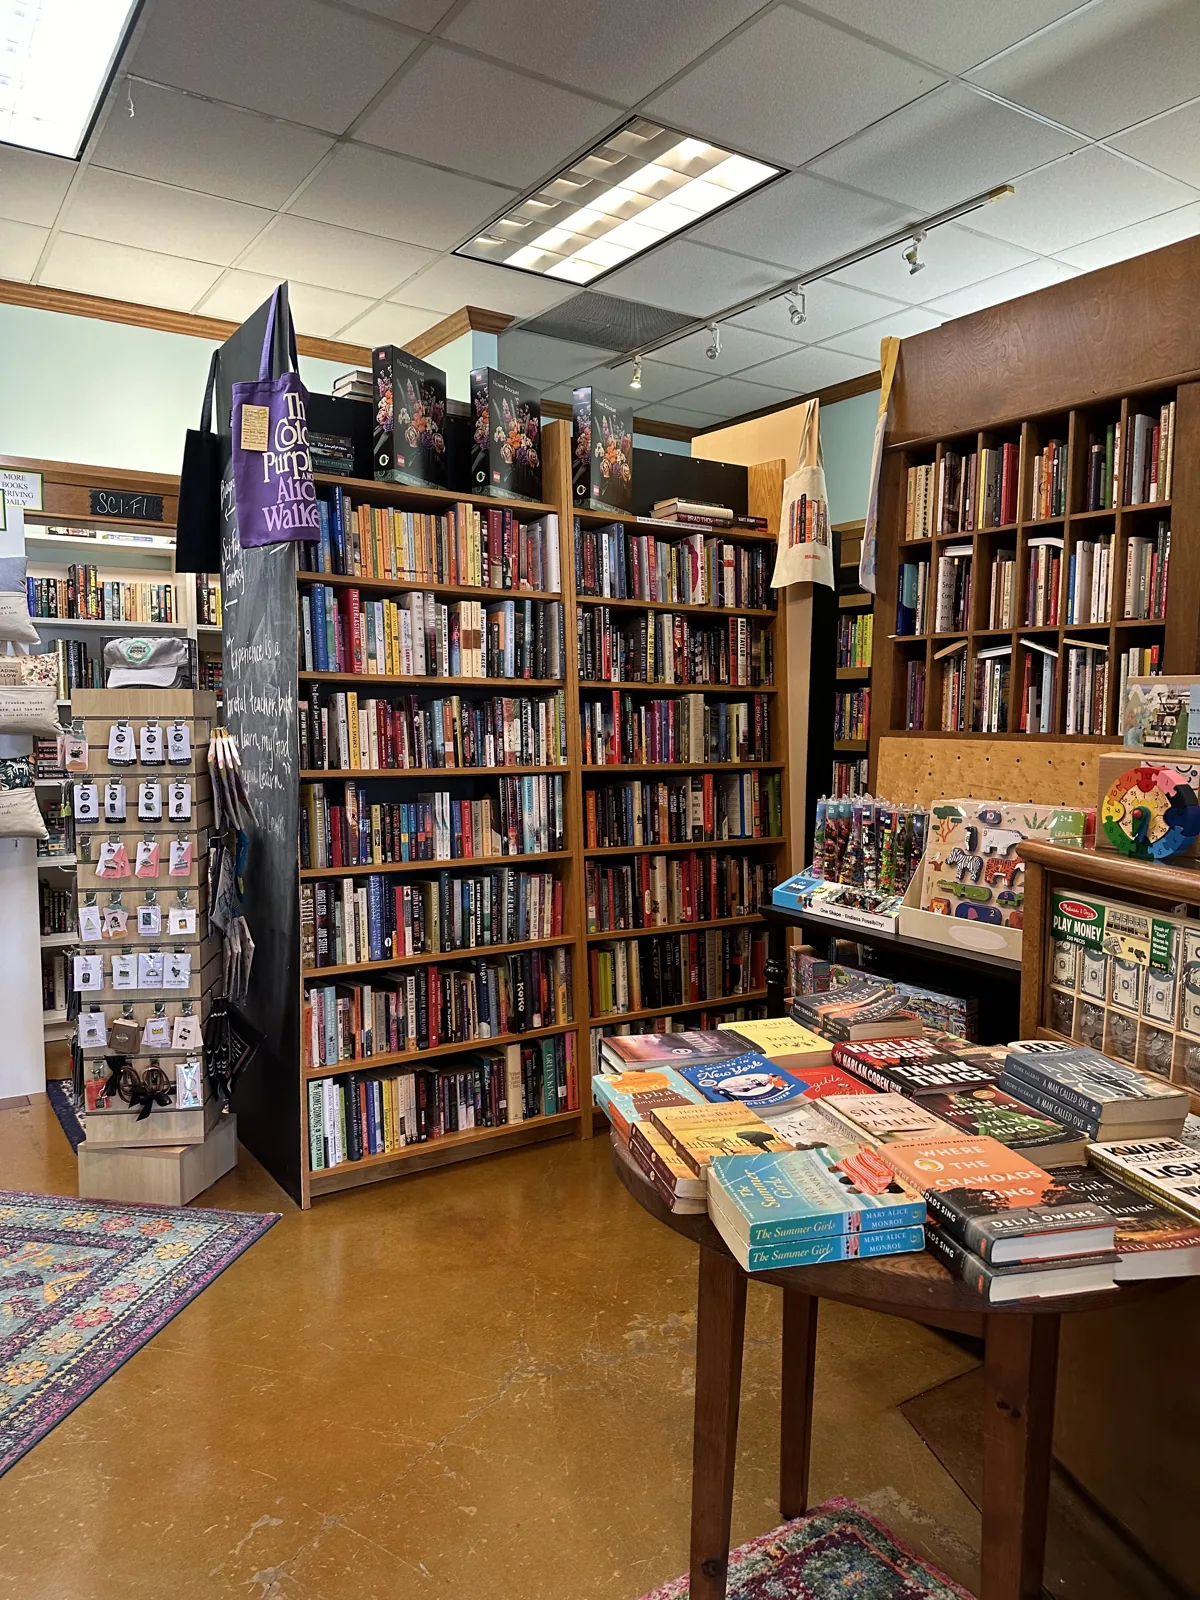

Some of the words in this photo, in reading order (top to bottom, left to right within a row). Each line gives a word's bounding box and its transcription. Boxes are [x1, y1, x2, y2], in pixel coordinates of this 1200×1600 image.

[396, 359, 409, 370] Flower
[409, 365, 425, 377] Bouquet
[492, 381, 505, 390] Flower
[505, 386, 520, 396] Bouquet
[283, 393, 306, 419] Th
[604, 403, 617, 414] Bouquet
[262, 450, 313, 483] Purpl
[4, 473, 26, 482] MORE
[2, 482, 29, 490] BOOKS
[277, 476, 316, 504] Alic
[4, 490, 34, 499] RRIVING
[6, 498, 27, 506] DAILY
[97, 492, 147, 516] SCI-FI
[262, 503, 320, 531] Walke
[264, 641, 274, 660] is
[274, 647, 281, 657] a
[311, 684, 319, 692] The
[226, 687, 248, 719] brutal
[279, 681, 293, 727] but
[1126, 775, 1133, 783] 11
[1111, 789, 1118, 797] 10
[1109, 826, 1114, 834] 8
[318, 890, 326, 904] ANGEL
[301, 899, 314, 925] STEELE
[829, 909, 841, 918] Shape
[845, 913, 861, 922] Endless
[862, 917, 885, 928] Possibility!
[1053, 915, 1073, 934] PLAY
[1073, 920, 1102, 942] MONEY
[319, 938, 328, 954] STEELE
[1074, 936, 1086, 945] PIECES
[517, 982, 525, 1012] KOKO
[813, 987, 874, 1006] TENDER
[846, 1039, 935, 1054] HARLAN
[867, 1047, 941, 1061] COBEN
[546, 1054, 554, 1079] GREEN
[697, 1067, 730, 1083] New
[730, 1060, 764, 1077] York
[842, 1055, 867, 1080] HARLAN
[866, 1069, 890, 1092] COBEN
[614, 1087, 691, 1102] Oliphant
[767, 1091, 792, 1104] SILVER
[1048, 1081, 1060, 1095] MAN
[1060, 1087, 1077, 1106] CALLED
[1077, 1097, 1090, 1112] OVE
[313, 1091, 322, 1128] HOMECOMING
[850, 1105, 917, 1118] SILENT
[945, 1101, 1019, 1118] HUSBANDS
[1041, 1099, 1053, 1112] MAN
[1053, 1105, 1073, 1123] CALLED
[1072, 1115, 1085, 1128] OVE
[859, 1115, 937, 1129] PATIENT
[971, 1115, 1037, 1130] EVELYN
[991, 1123, 1041, 1135] HUGO
[919, 1145, 985, 1157] WHERE
[1103, 1141, 1186, 1156] KWAME
[949, 1159, 990, 1169] THE
[1122, 1151, 1196, 1163] ALEXANDER
[934, 1170, 1048, 1187] CRAWDADS
[982, 1187, 1035, 1201] SING
[1068, 1180, 1114, 1193] Girls
[910, 1181, 940, 1210] CRAWDADS
[941, 1206, 957, 1222] SING
[1087, 1193, 1110, 1203] the
[866, 1211, 886, 1220] MARY
[888, 1208, 908, 1217] ALICE
[991, 1215, 1038, 1228] DELIA
[1040, 1210, 1097, 1223] OWENS
[871, 1218, 903, 1228] MONROE
[755, 1229, 772, 1240] The
[774, 1226, 810, 1238] Summer
[813, 1222, 836, 1234] Girls
[863, 1236, 883, 1244] MARY
[887, 1233, 907, 1242] ALICE
[752, 1251, 770, 1264] The
[771, 1249, 808, 1261] Summer
[811, 1245, 834, 1256] Girls
[869, 1243, 902, 1252] MONROE
[940, 1242, 955, 1258] SING
